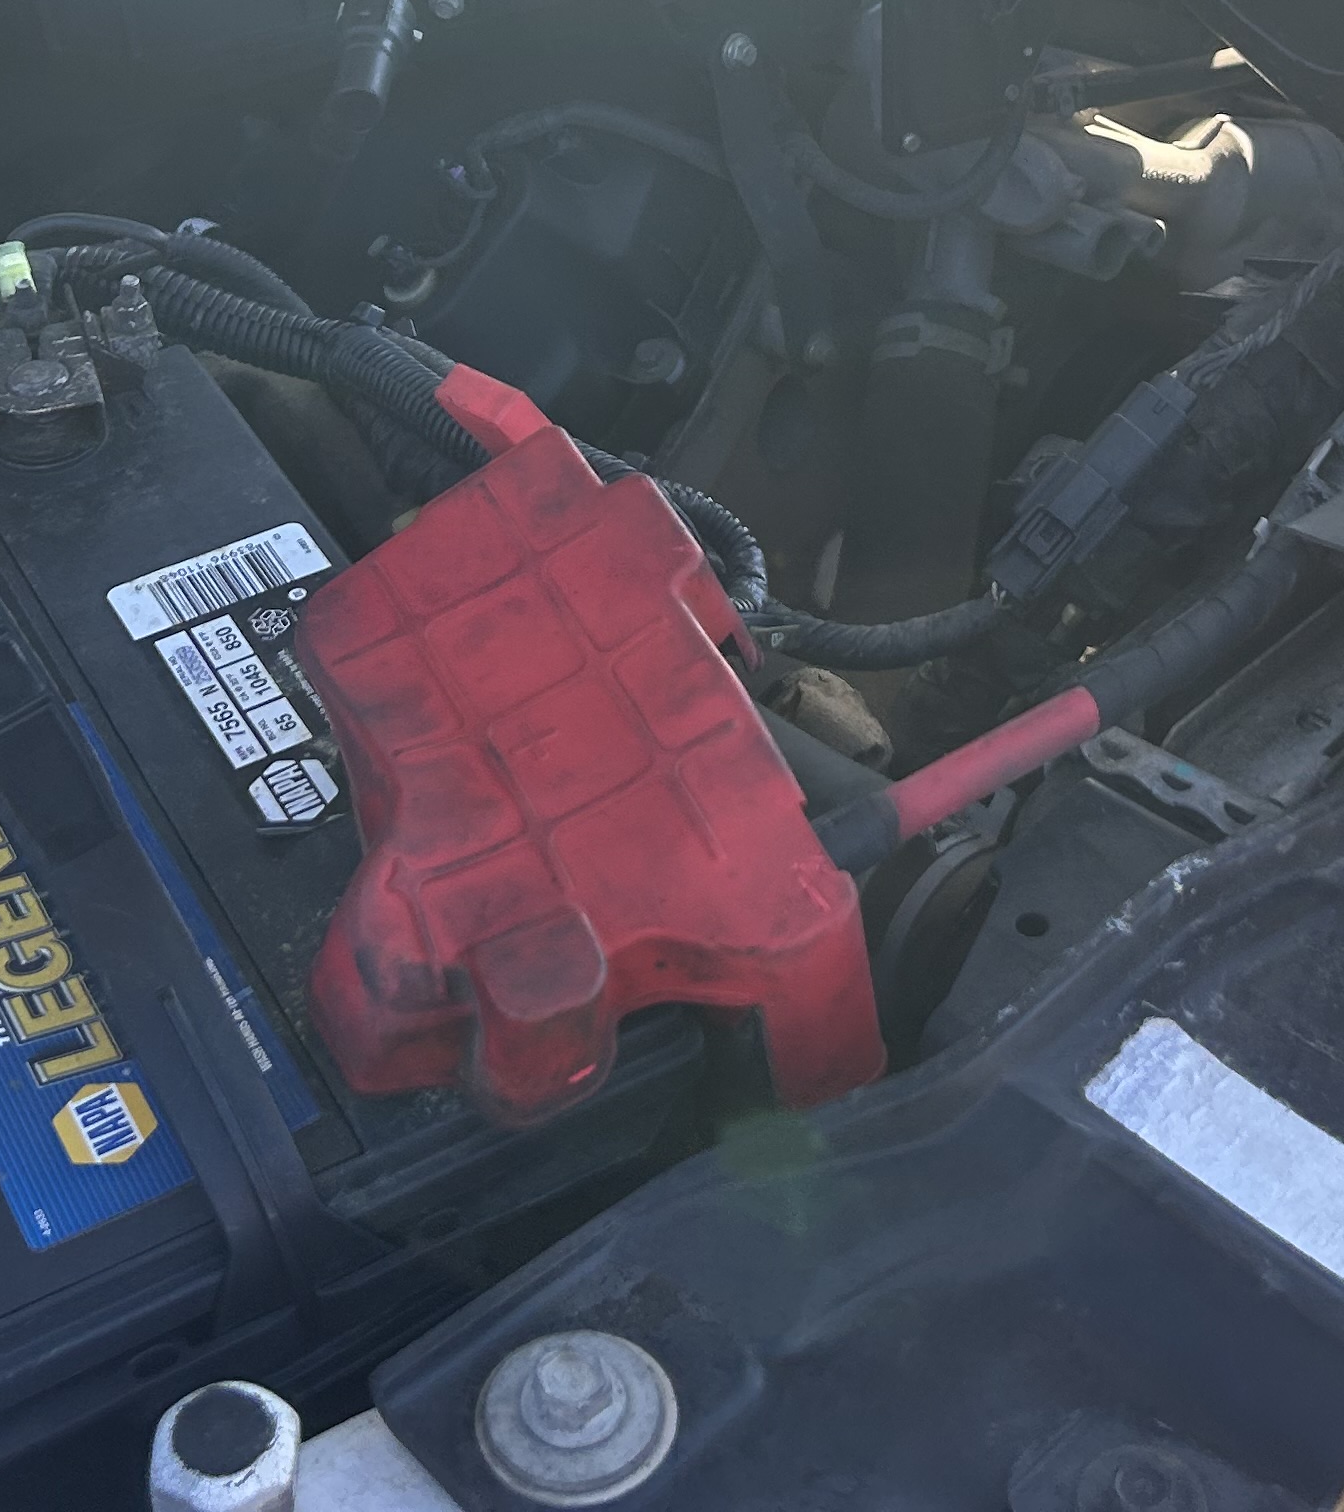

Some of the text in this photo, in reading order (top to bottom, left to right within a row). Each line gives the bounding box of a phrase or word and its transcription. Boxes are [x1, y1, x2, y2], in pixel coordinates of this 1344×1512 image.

[209, 541, 255, 565] 83996
[158, 560, 203, 585] 11048
[214, 624, 243, 652] 850
[239, 661, 273, 697] 1045
[198, 682, 246, 742] 7565 N
[273, 711, 298, 732] 65
[265, 763, 322, 814] NAPA
[72, 1089, 139, 1156] NAPA
